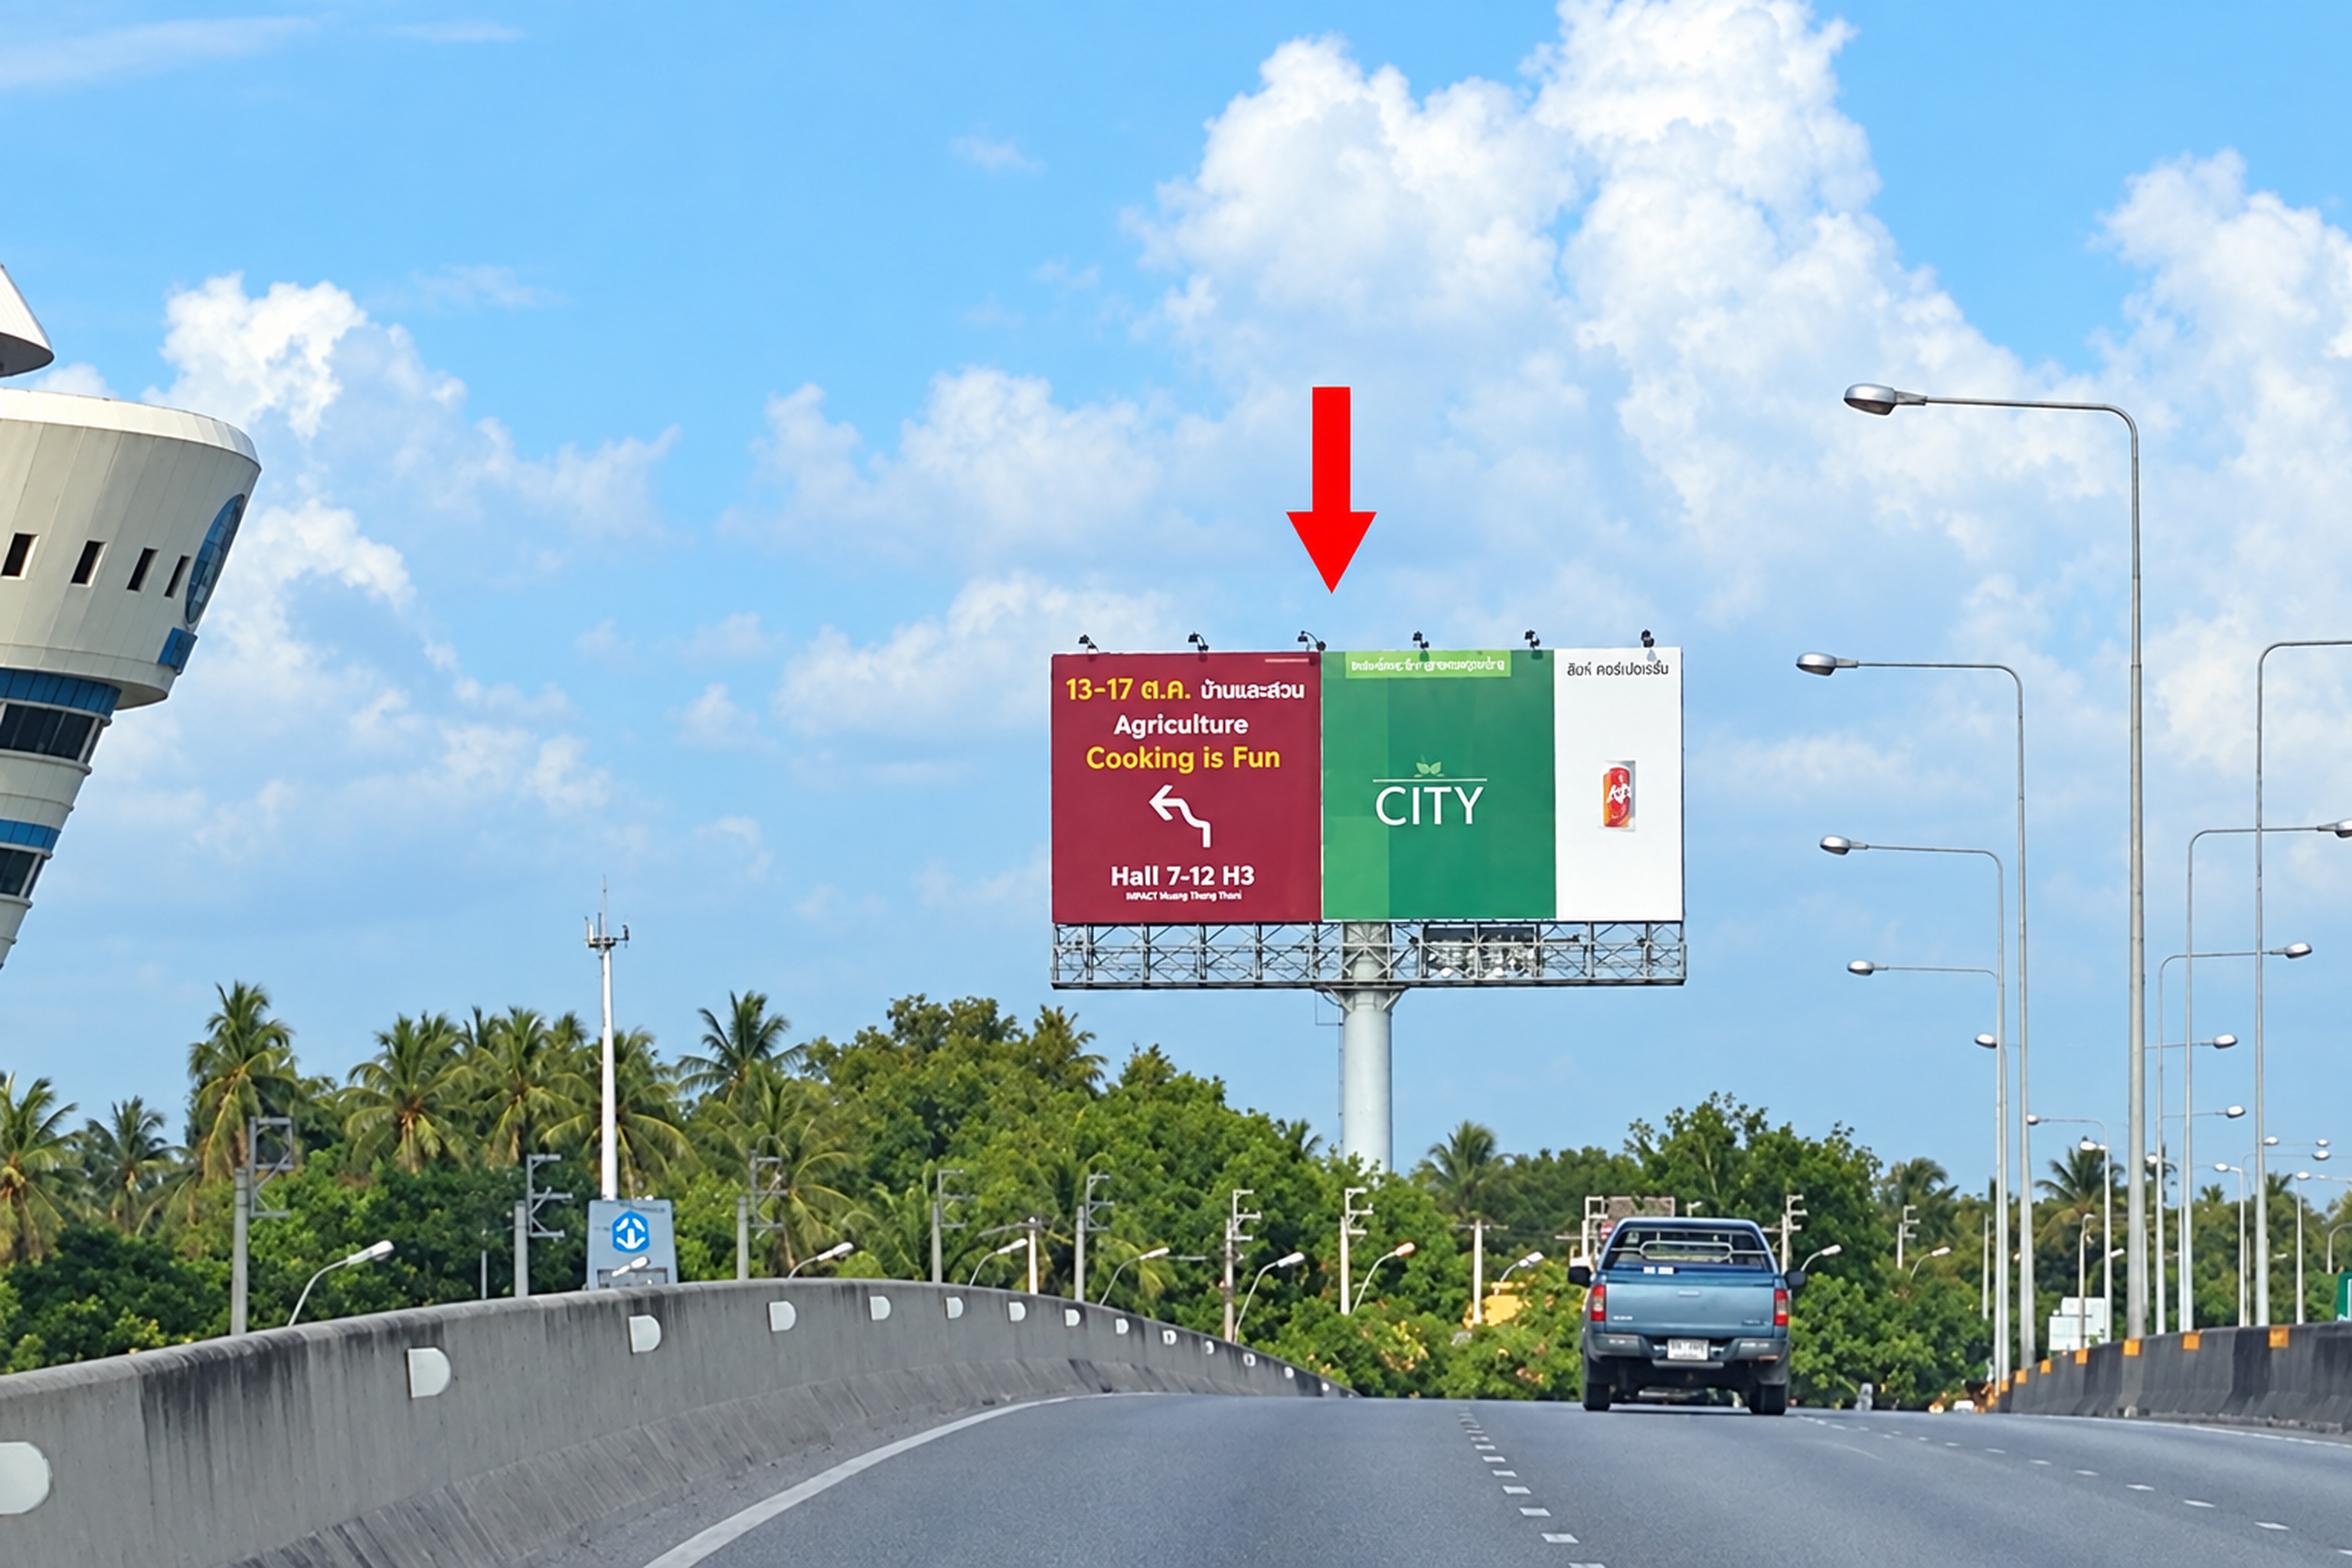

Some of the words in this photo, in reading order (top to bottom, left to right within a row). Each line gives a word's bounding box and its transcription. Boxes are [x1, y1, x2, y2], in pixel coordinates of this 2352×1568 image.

[1066, 678, 1133, 701] 13-17
[1141, 680, 1191, 700] ต.ค.
[1200, 678, 1305, 700] บ้านและสวน
[1113, 713, 1249, 740] Agriculture
[1086, 746, 1194, 775] Cooking
[1203, 746, 1224, 769] is
[1233, 746, 1280, 768] Fun
[1375, 786, 1485, 826] CITY
[1111, 865, 1159, 887] Hall
[1166, 865, 1215, 886] 7-12
[1223, 865, 1255, 886] H3
